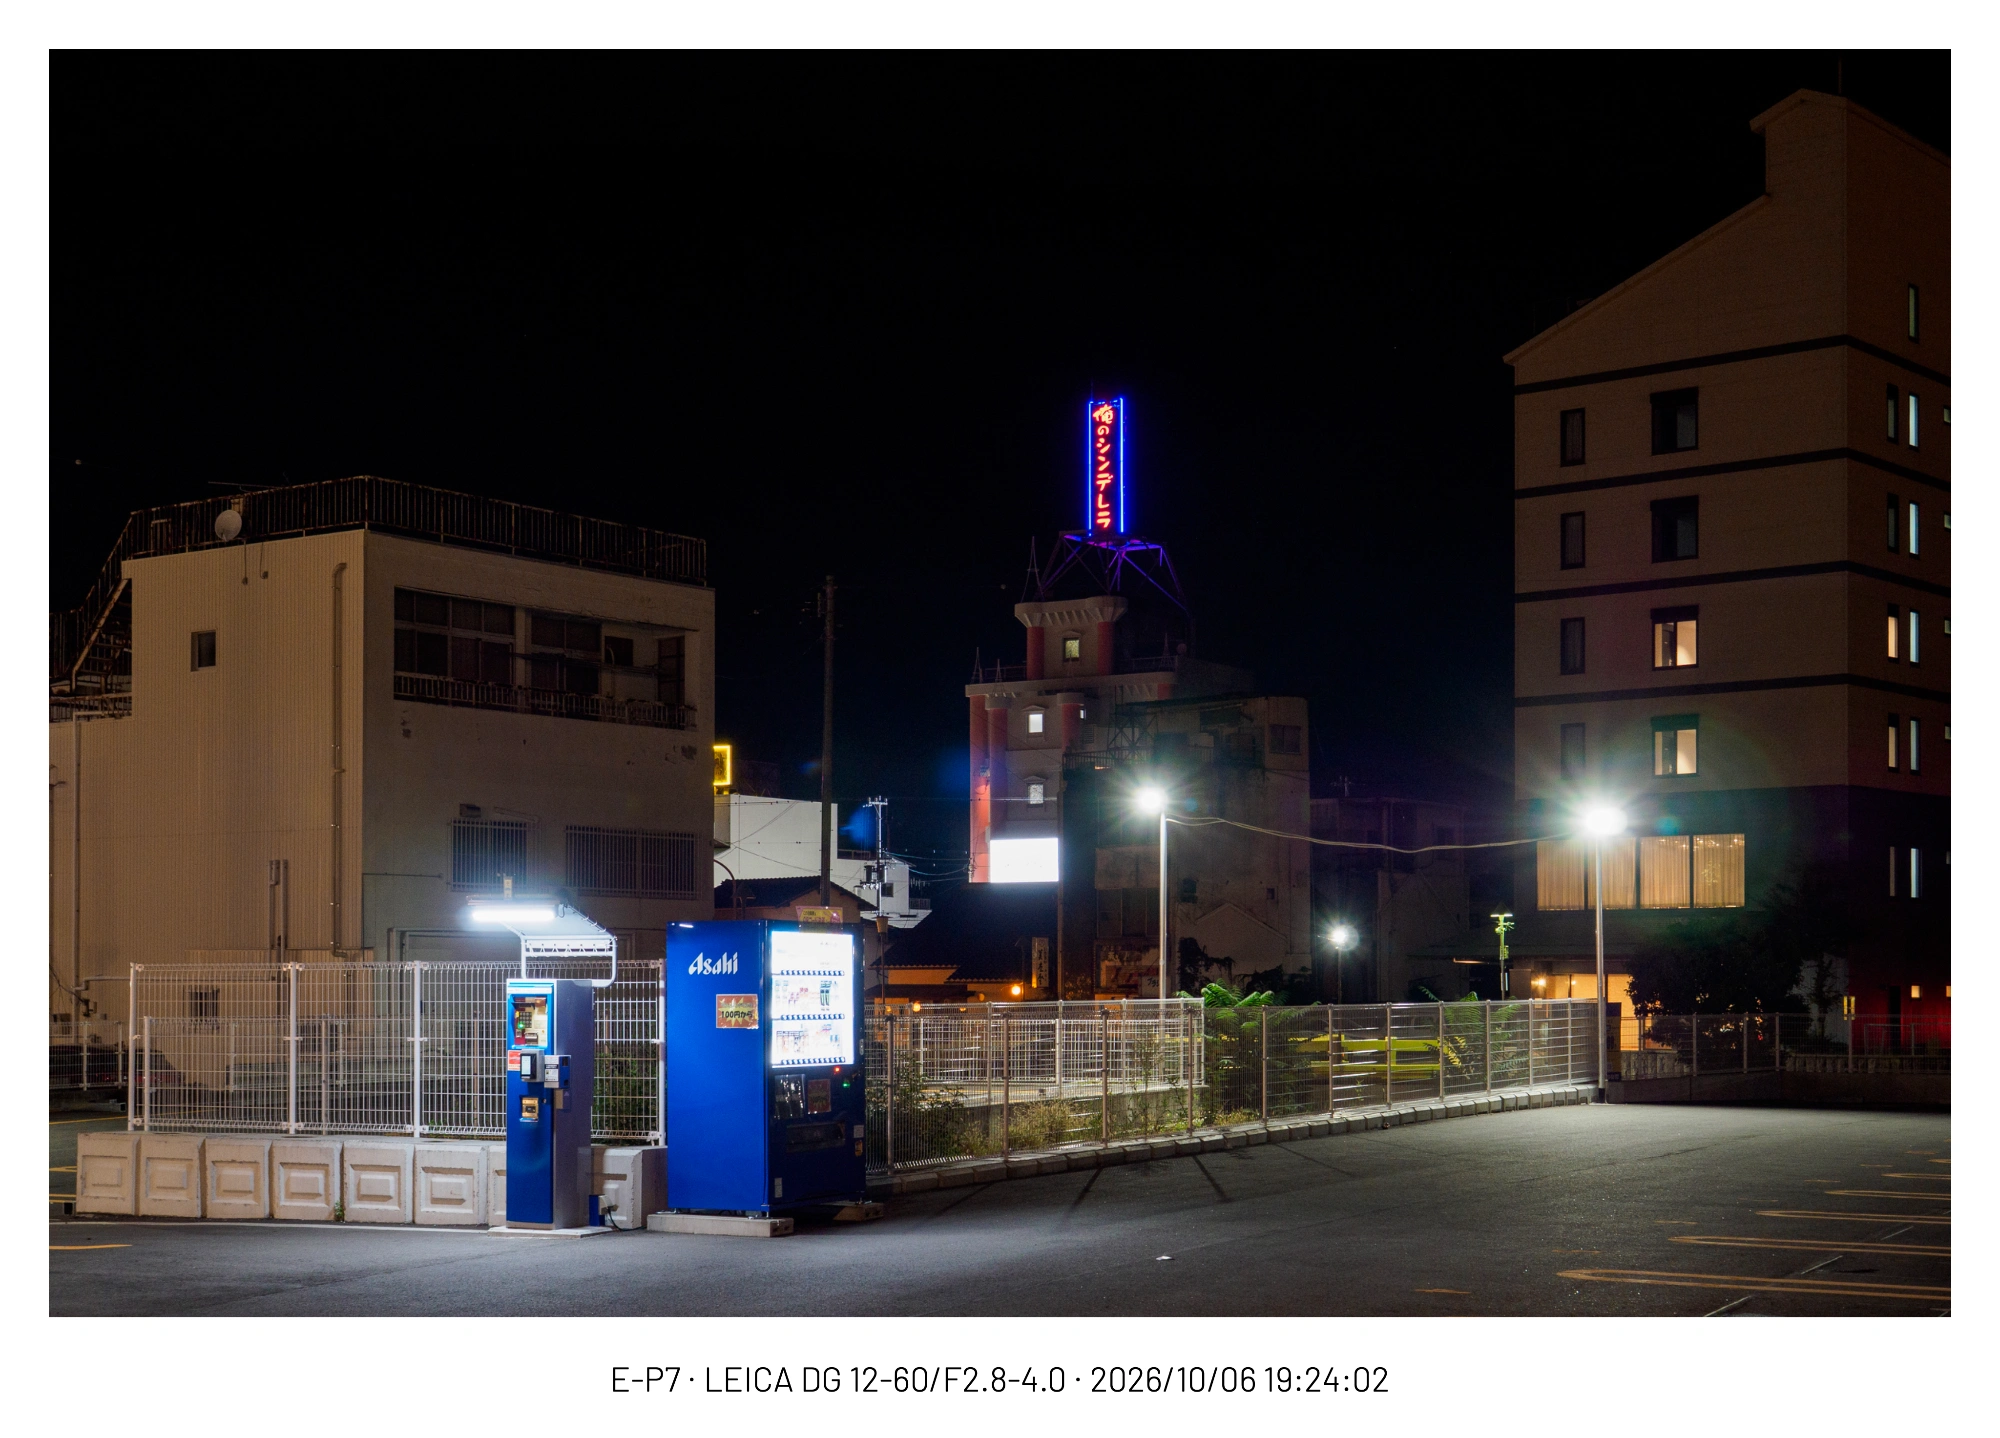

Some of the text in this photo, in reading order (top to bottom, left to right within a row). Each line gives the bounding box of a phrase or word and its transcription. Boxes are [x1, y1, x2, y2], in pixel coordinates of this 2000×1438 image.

[1092, 403, 1114, 528] 俺のシンデレラ
[688, 951, 738, 976] Asahi
[721, 1010, 753, 1019] 100円から
